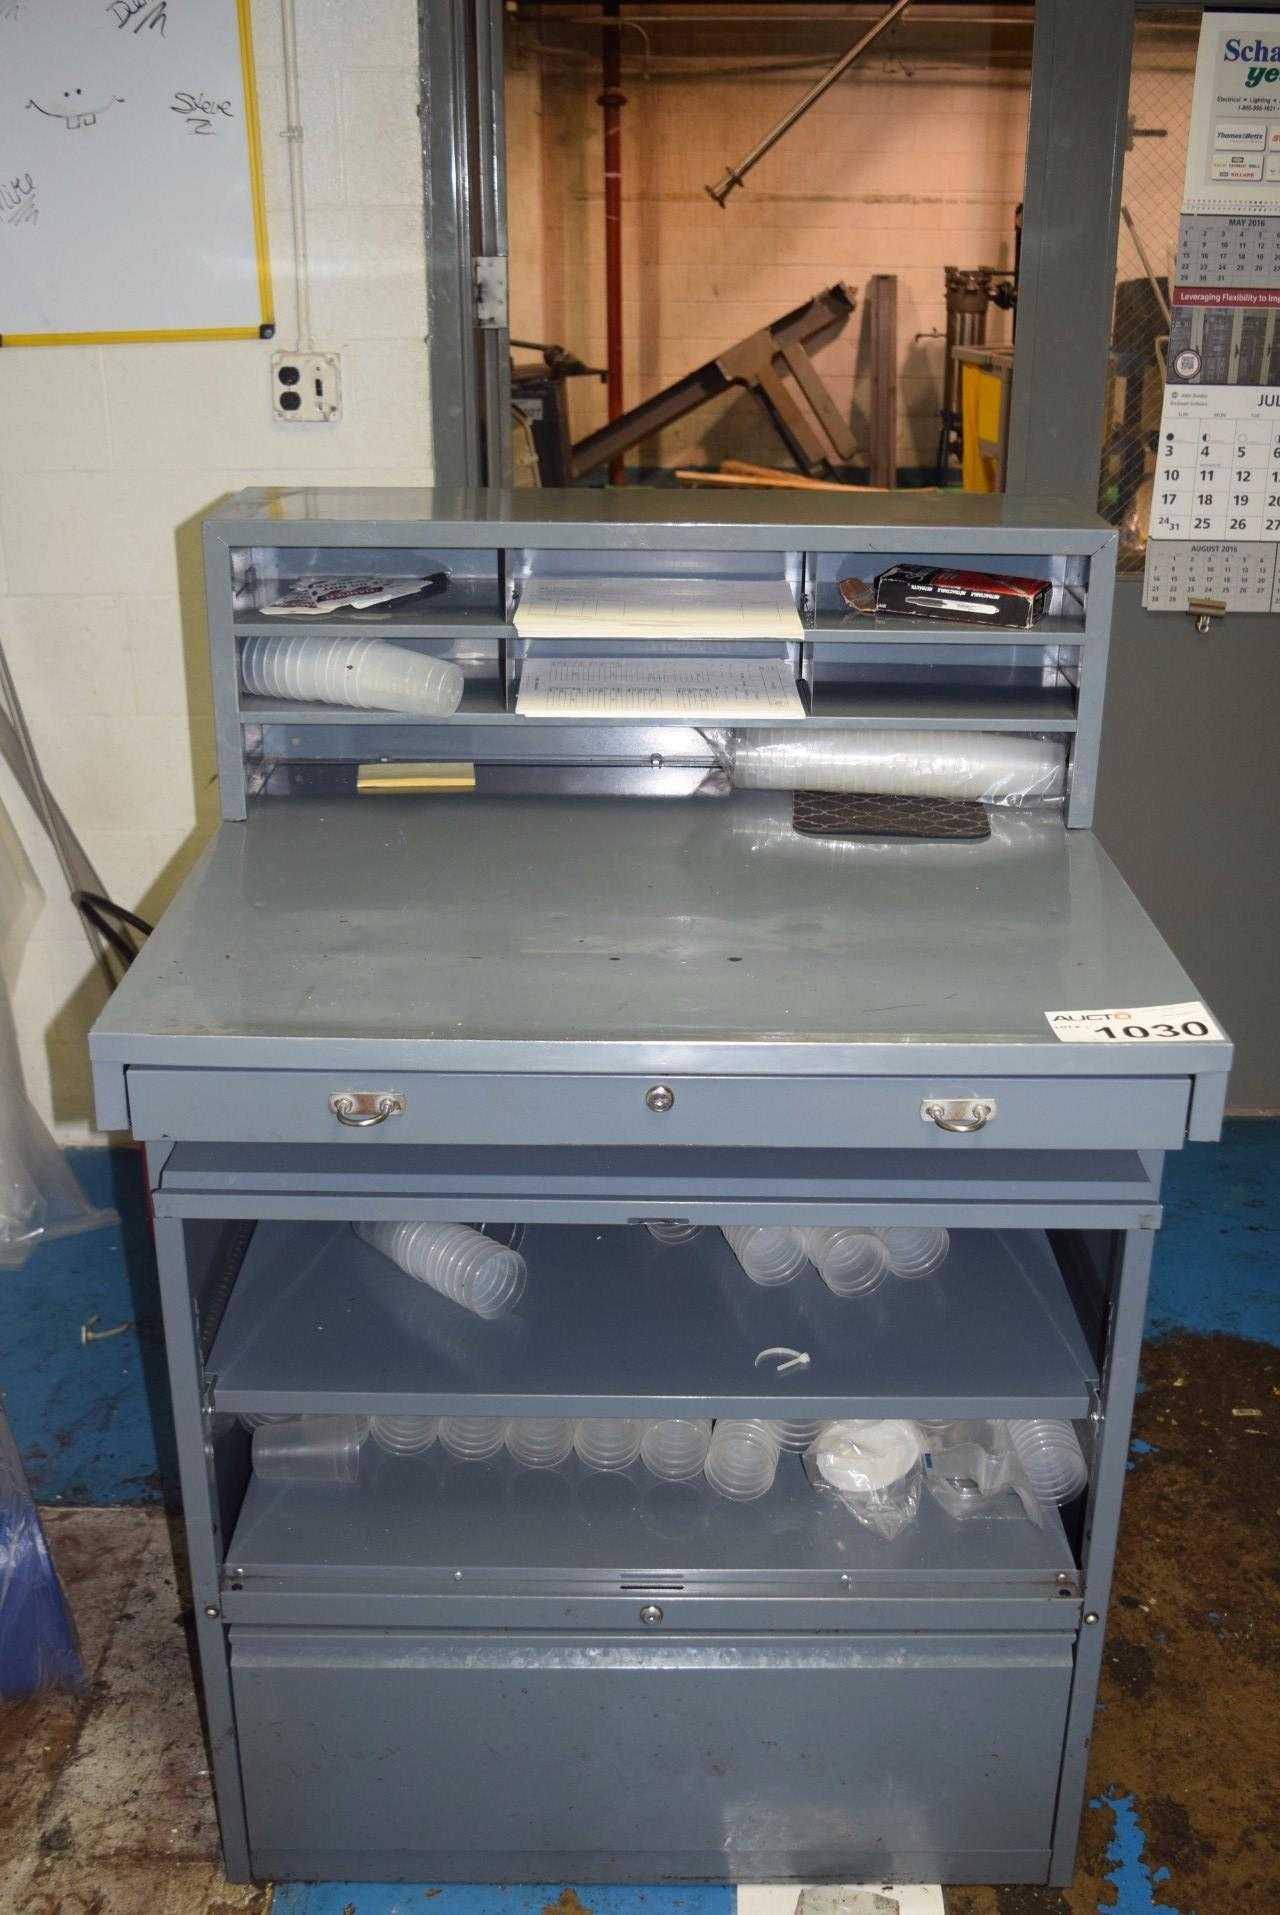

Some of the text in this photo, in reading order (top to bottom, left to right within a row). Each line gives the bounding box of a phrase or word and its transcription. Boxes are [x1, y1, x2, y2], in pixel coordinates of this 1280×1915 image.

[1224, 38, 1280, 62] Scha
[1245, 67, 1280, 88] ye
[1180, 292, 1220, 302] Leveraging
[1222, 293, 1257, 303] Flexibility
[1165, 445, 1173, 456] 3
[1201, 446, 1210, 457] 4
[1238, 446, 1246, 458] 5
[1164, 469, 1280, 483] 10 11 12 1
[1162, 493, 1177, 505] 17
[1198, 494, 1213, 505] 18
[1233, 495, 1249, 506] 19
[1158, 517, 1280, 531] 24 31 25 26 27
[1053, 1011, 1132, 1022] AUCTO
[1094, 1021, 1209, 1039] 1030
